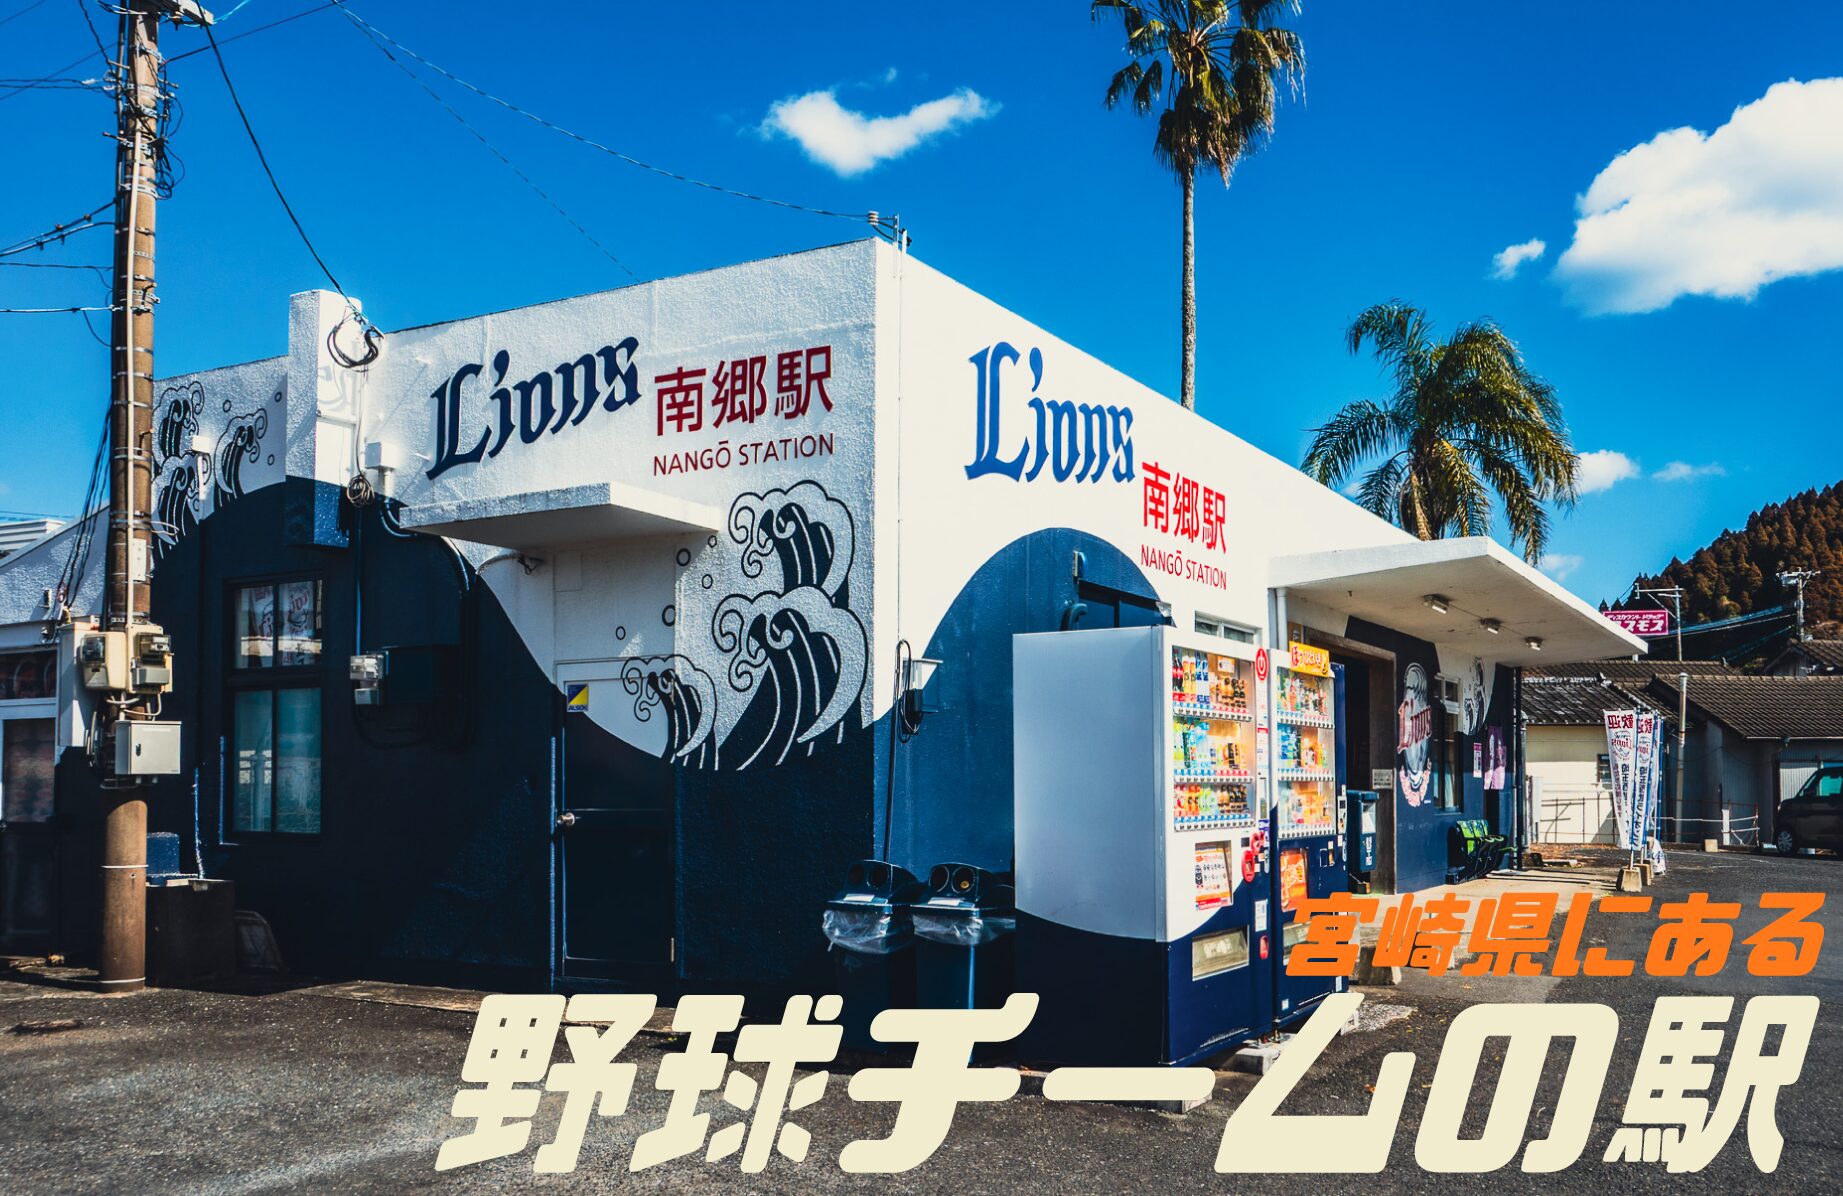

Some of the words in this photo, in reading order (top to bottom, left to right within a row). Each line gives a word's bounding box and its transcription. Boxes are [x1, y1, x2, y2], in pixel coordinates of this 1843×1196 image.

[654, 345, 833, 436] 南郷駅
[653, 440, 732, 476] NANGŌ
[738, 433, 834, 466] STATION
[1142, 461, 1227, 554] 南郷駅
[1141, 544, 1183, 577] NANGŌ
[1186, 559, 1227, 590] STATION
